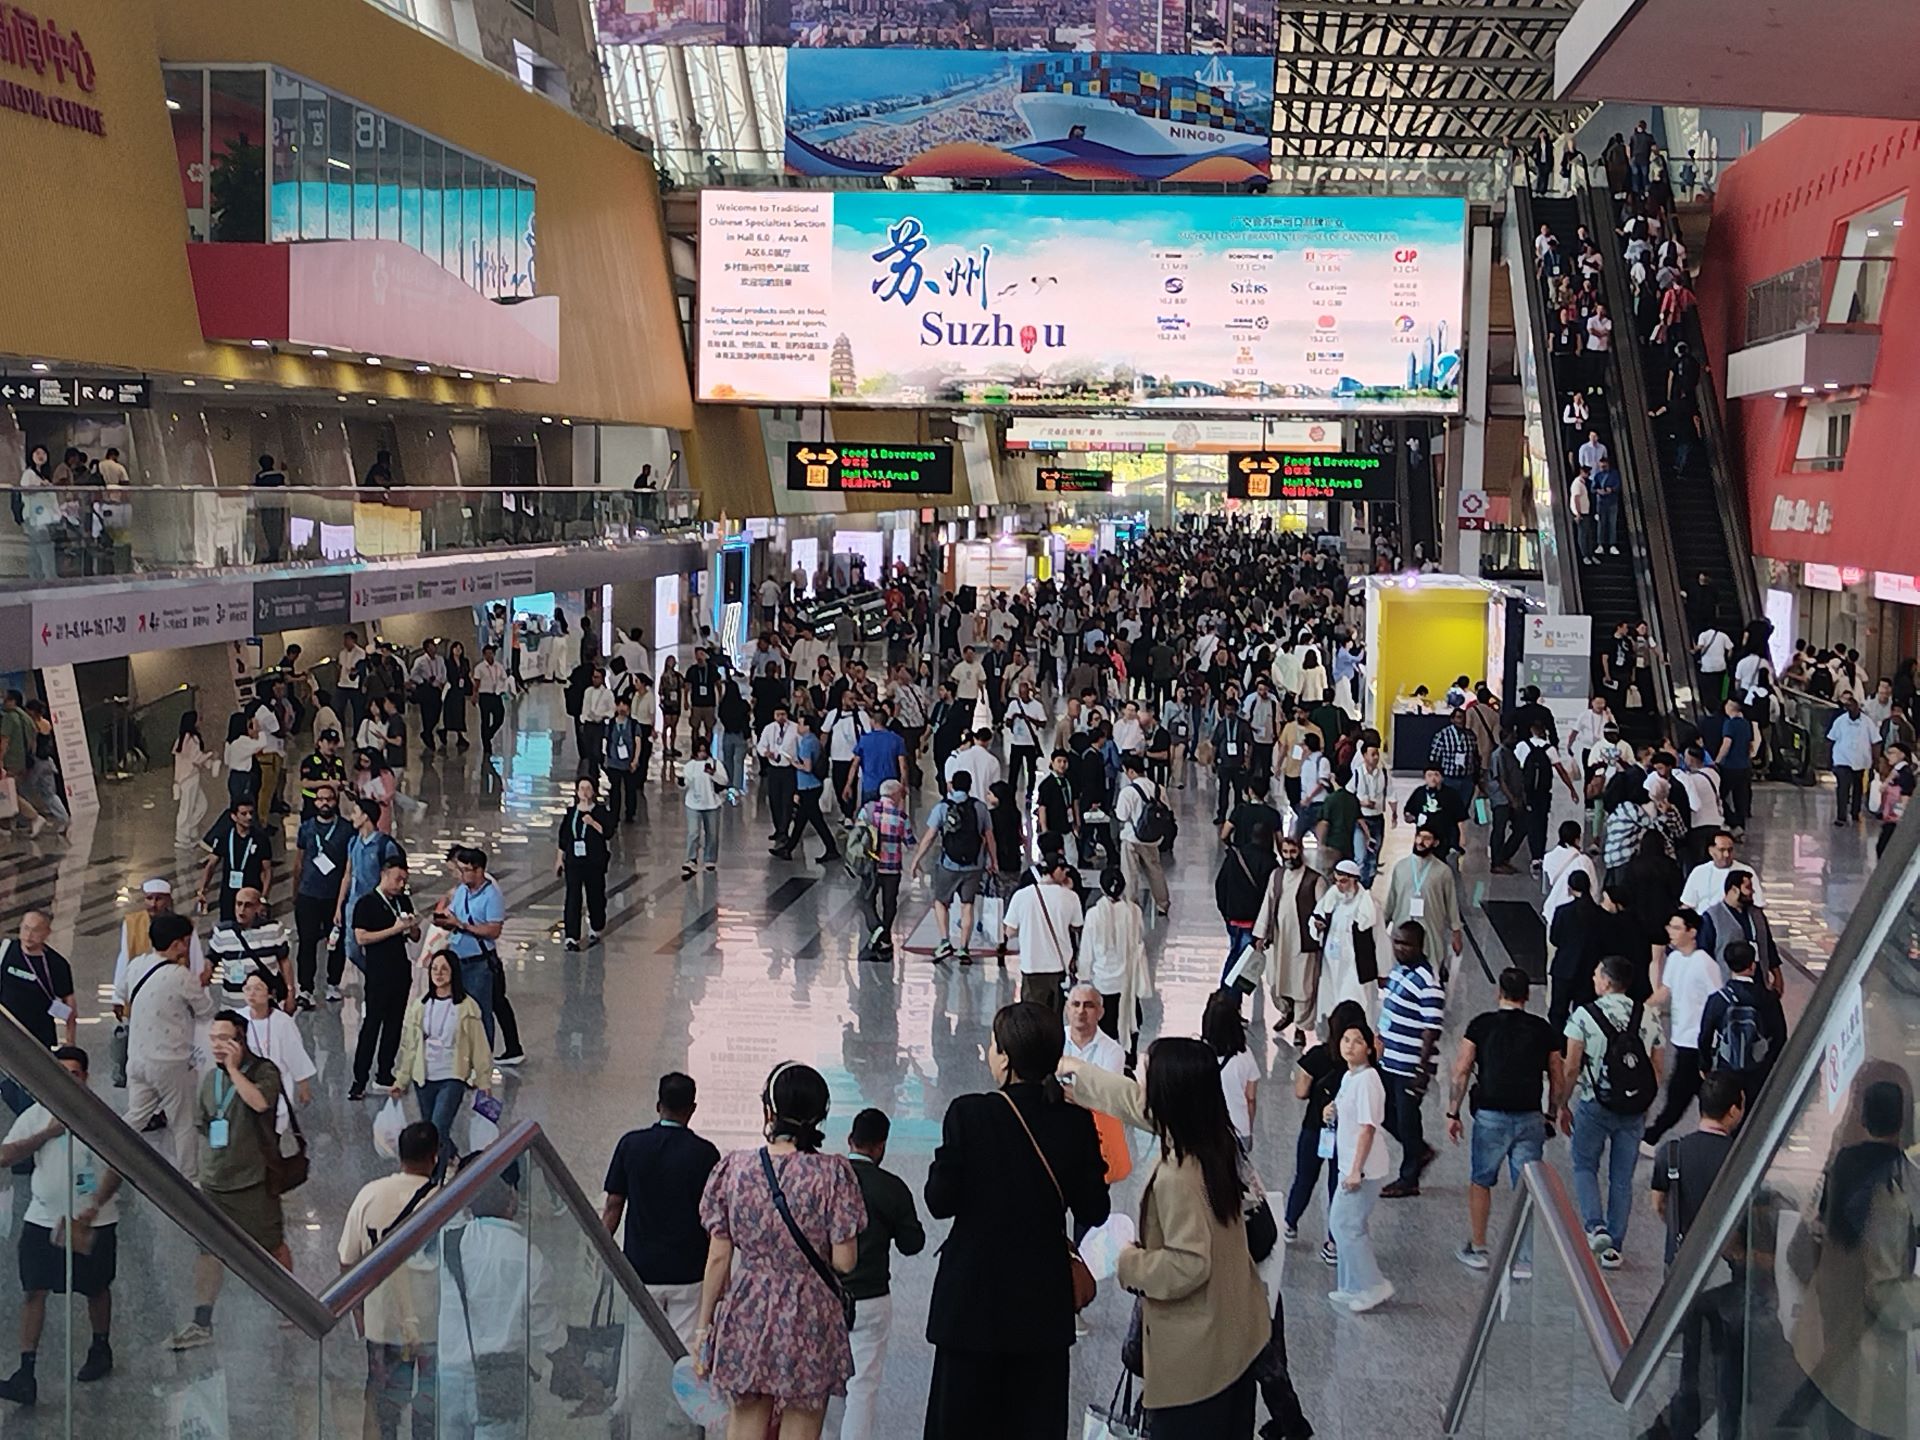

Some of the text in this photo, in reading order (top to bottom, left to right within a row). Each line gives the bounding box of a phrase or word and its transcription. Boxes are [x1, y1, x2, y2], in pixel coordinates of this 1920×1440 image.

[48, 96, 107, 137] CENTRE
[1170, 126, 1225, 143] NINGBO
[716, 203, 819, 213] Welcome to Traditional
[709, 218, 826, 228] Chinese Specialties Section
[726, 233, 735, 241] in
[737, 233, 754, 241] Hall
[778, 234, 798, 242] Area
[801, 234, 808, 242] A
[872, 219, 990, 310] 苏州
[744, 307, 777, 316] products
[755, 319, 784, 327] product
[921, 311, 1067, 354] Suzhou
[842, 448, 936, 462] Food & Beverages
[1284, 456, 1379, 470] Food & Beverages
[841, 469, 860, 478] Hall
[1283, 478, 1303, 487] Hall
